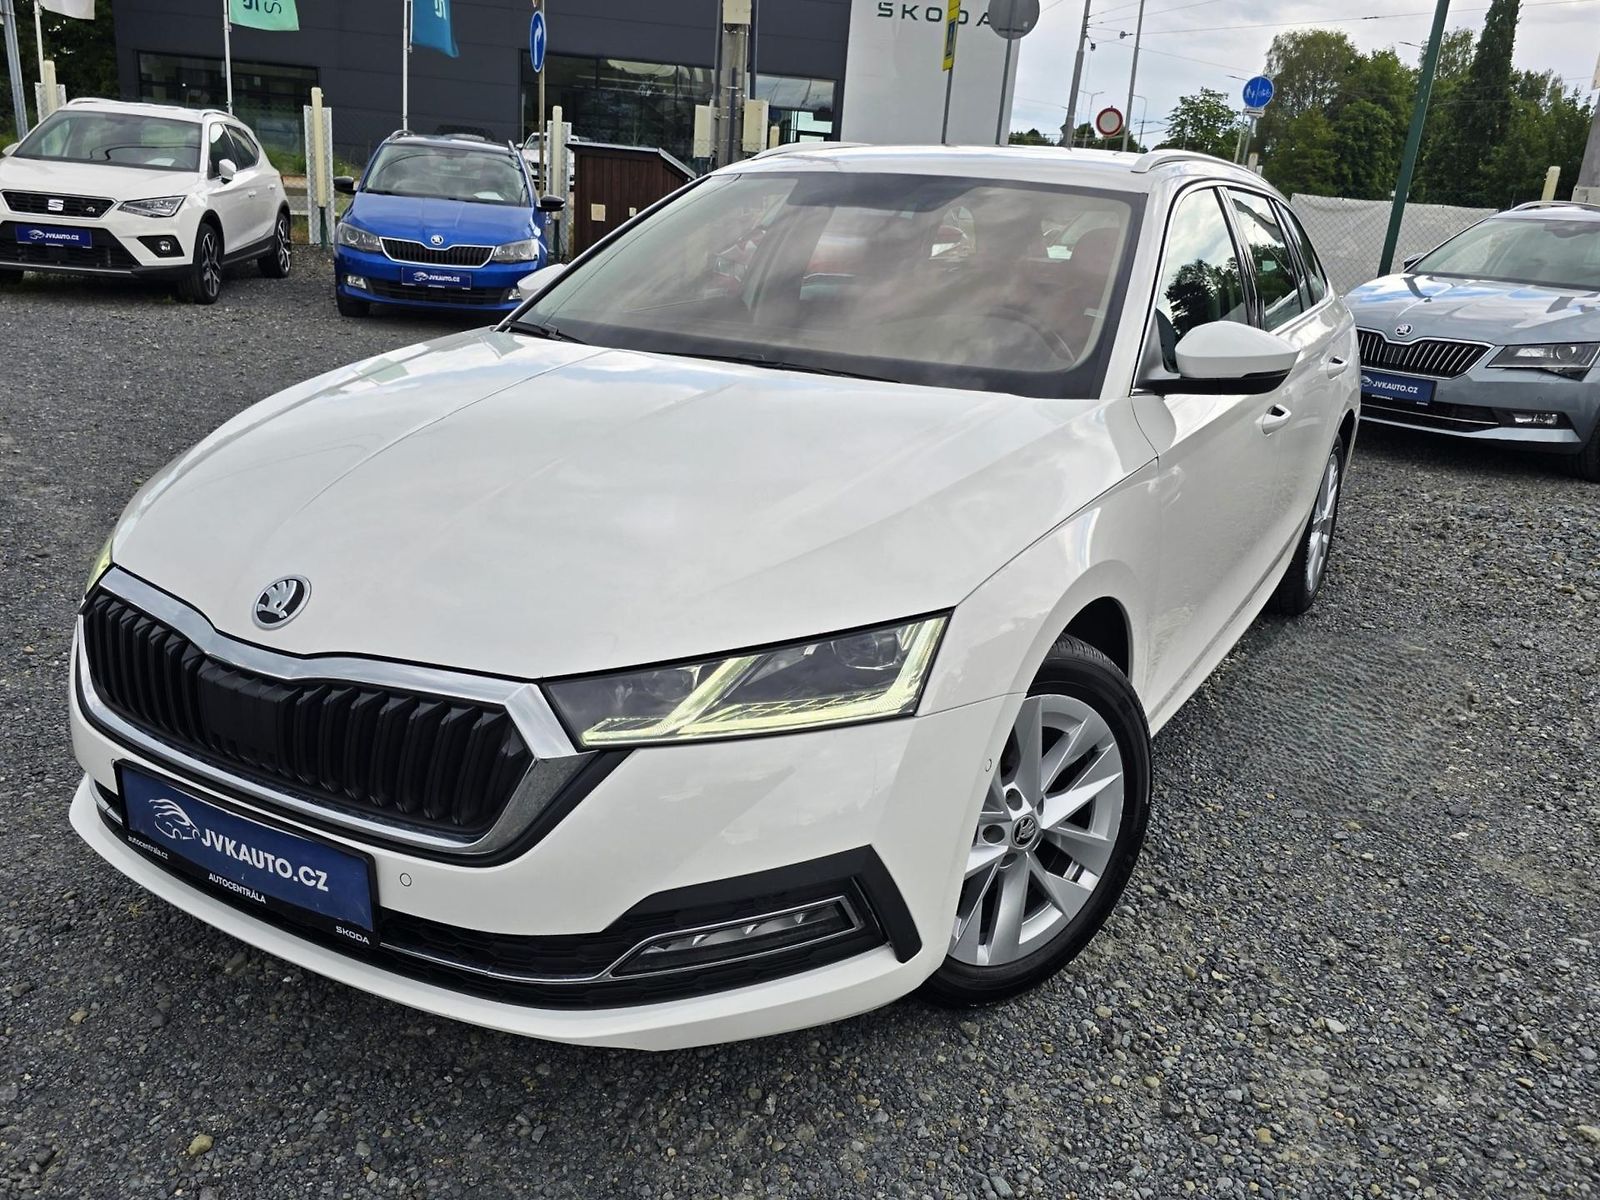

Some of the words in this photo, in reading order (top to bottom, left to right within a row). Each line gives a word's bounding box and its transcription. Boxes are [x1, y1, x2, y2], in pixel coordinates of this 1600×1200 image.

[45, 232, 80, 241] JVKAUTO.CZ
[1373, 380, 1419, 394] JVKAUTO.CZ
[201, 828, 329, 892] JVKAUTO.CZ
[208, 872, 267, 905] AUTOCENTRÁLA
